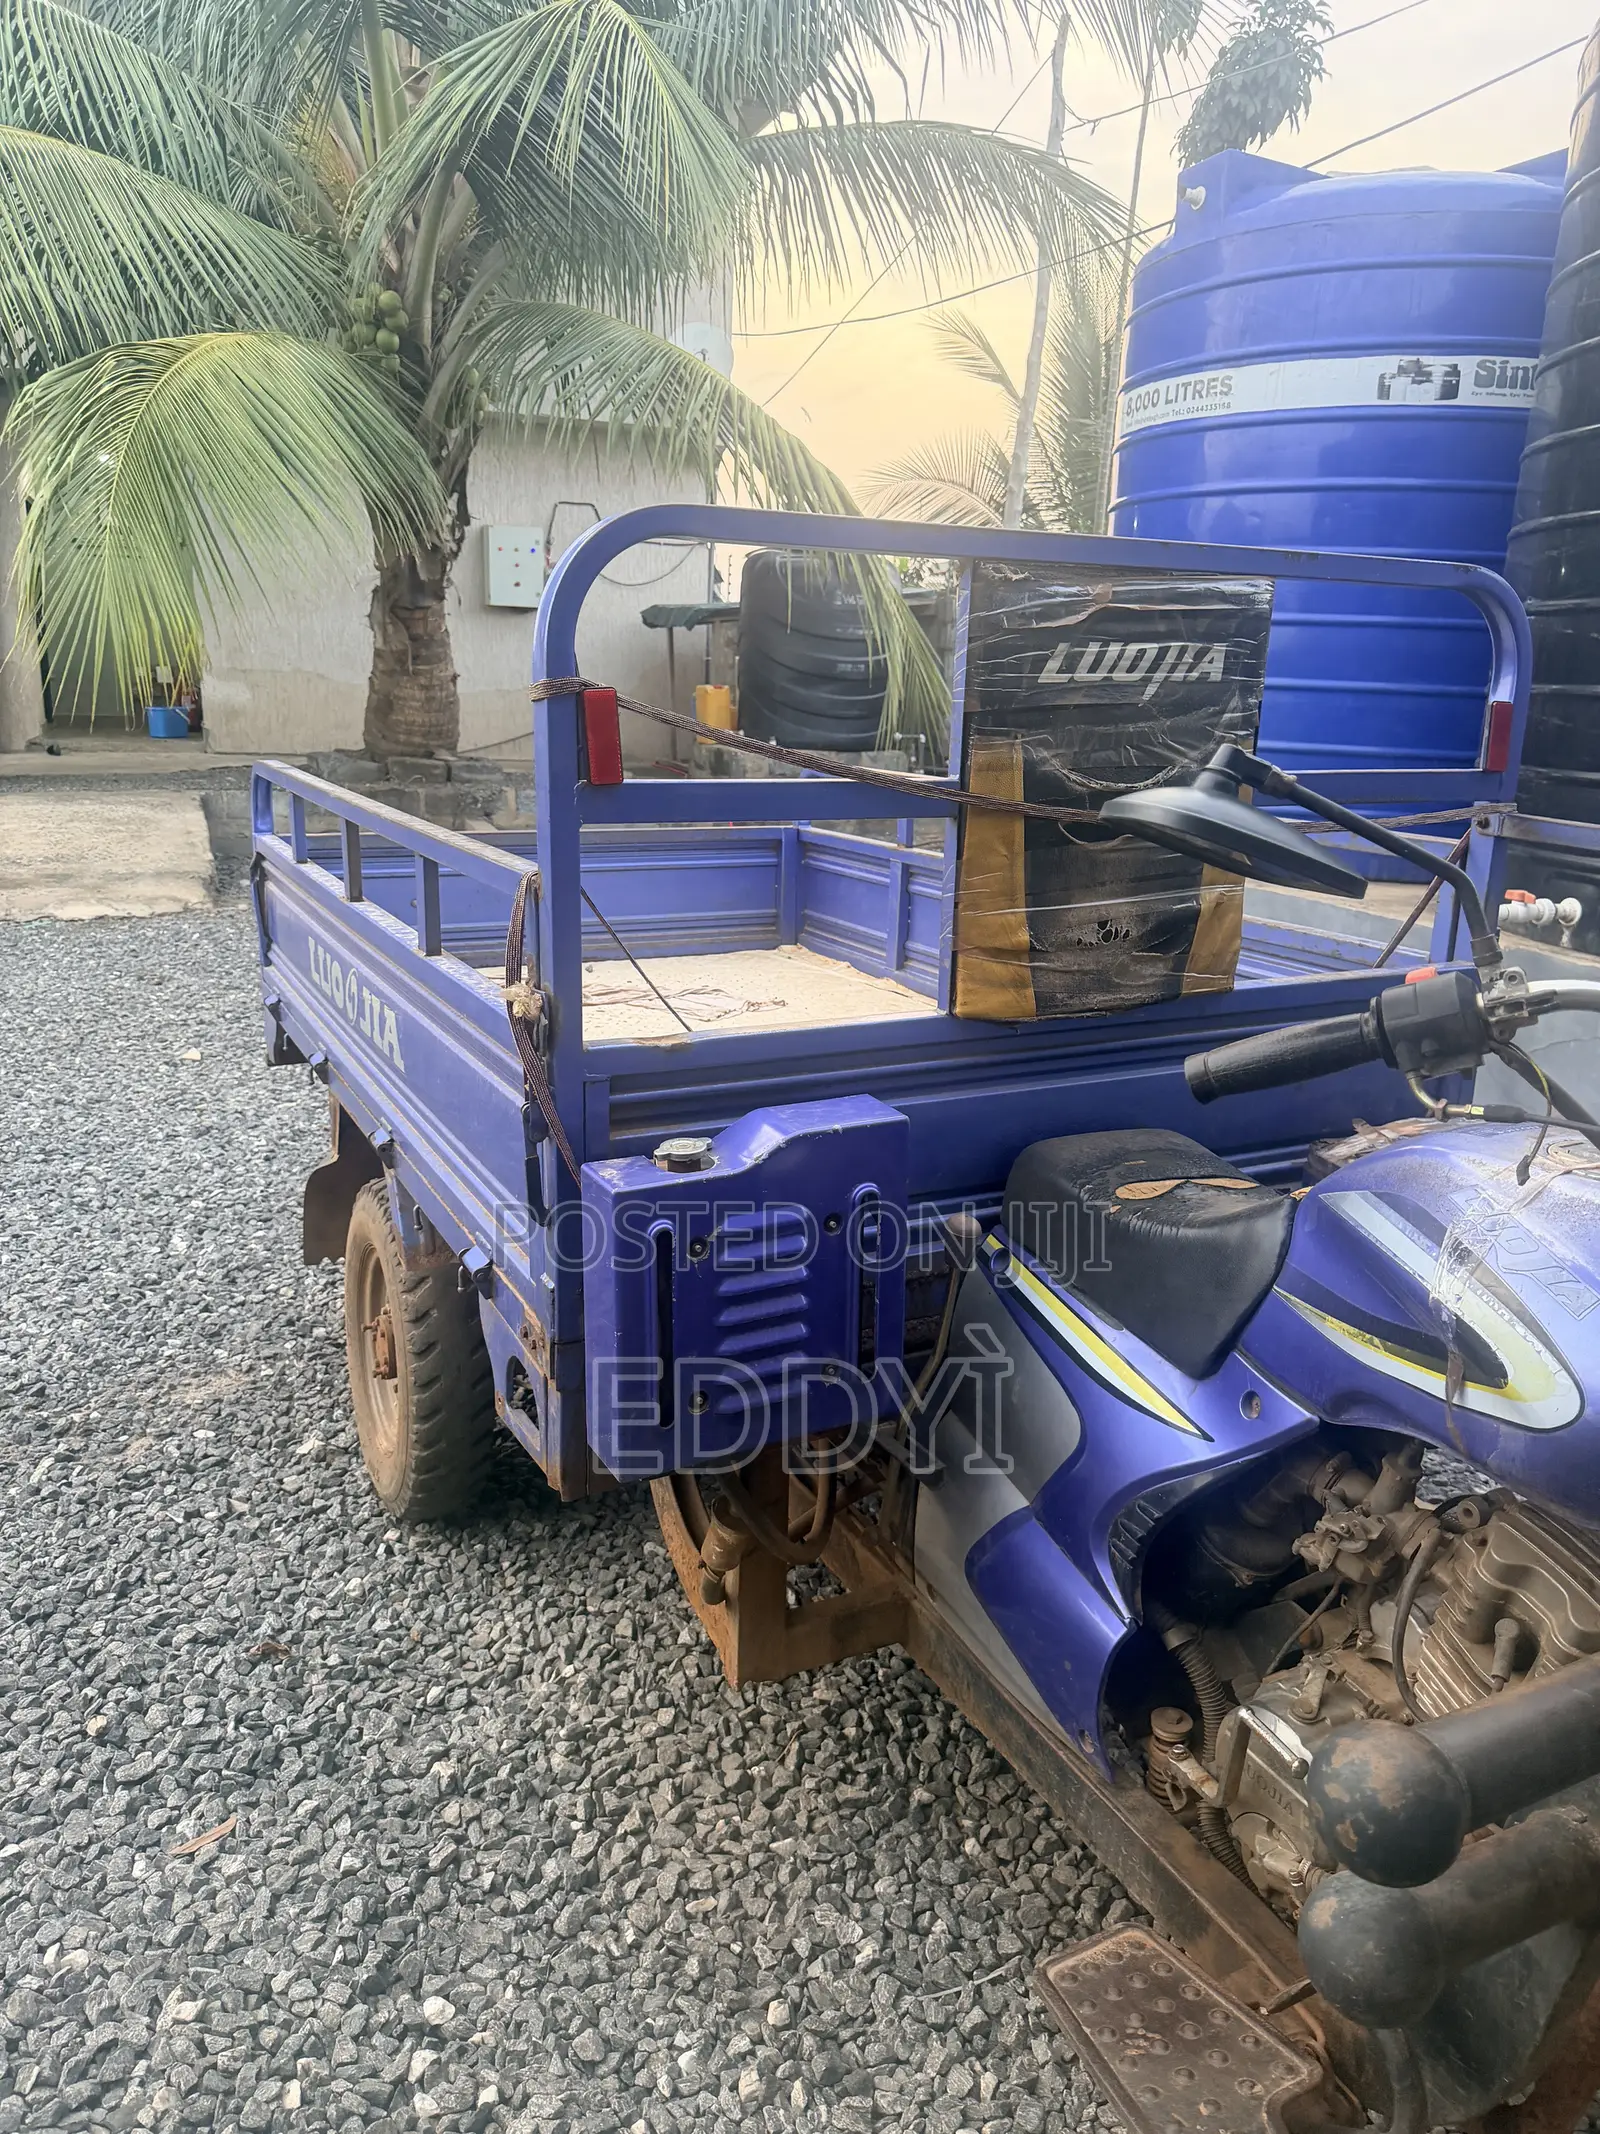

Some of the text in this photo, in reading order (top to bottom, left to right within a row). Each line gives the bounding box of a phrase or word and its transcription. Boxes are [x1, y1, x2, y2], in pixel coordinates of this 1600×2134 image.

[1126, 374, 1233, 419] 8,000 LITRES
[1036, 641, 1228, 702] LUOJIA
